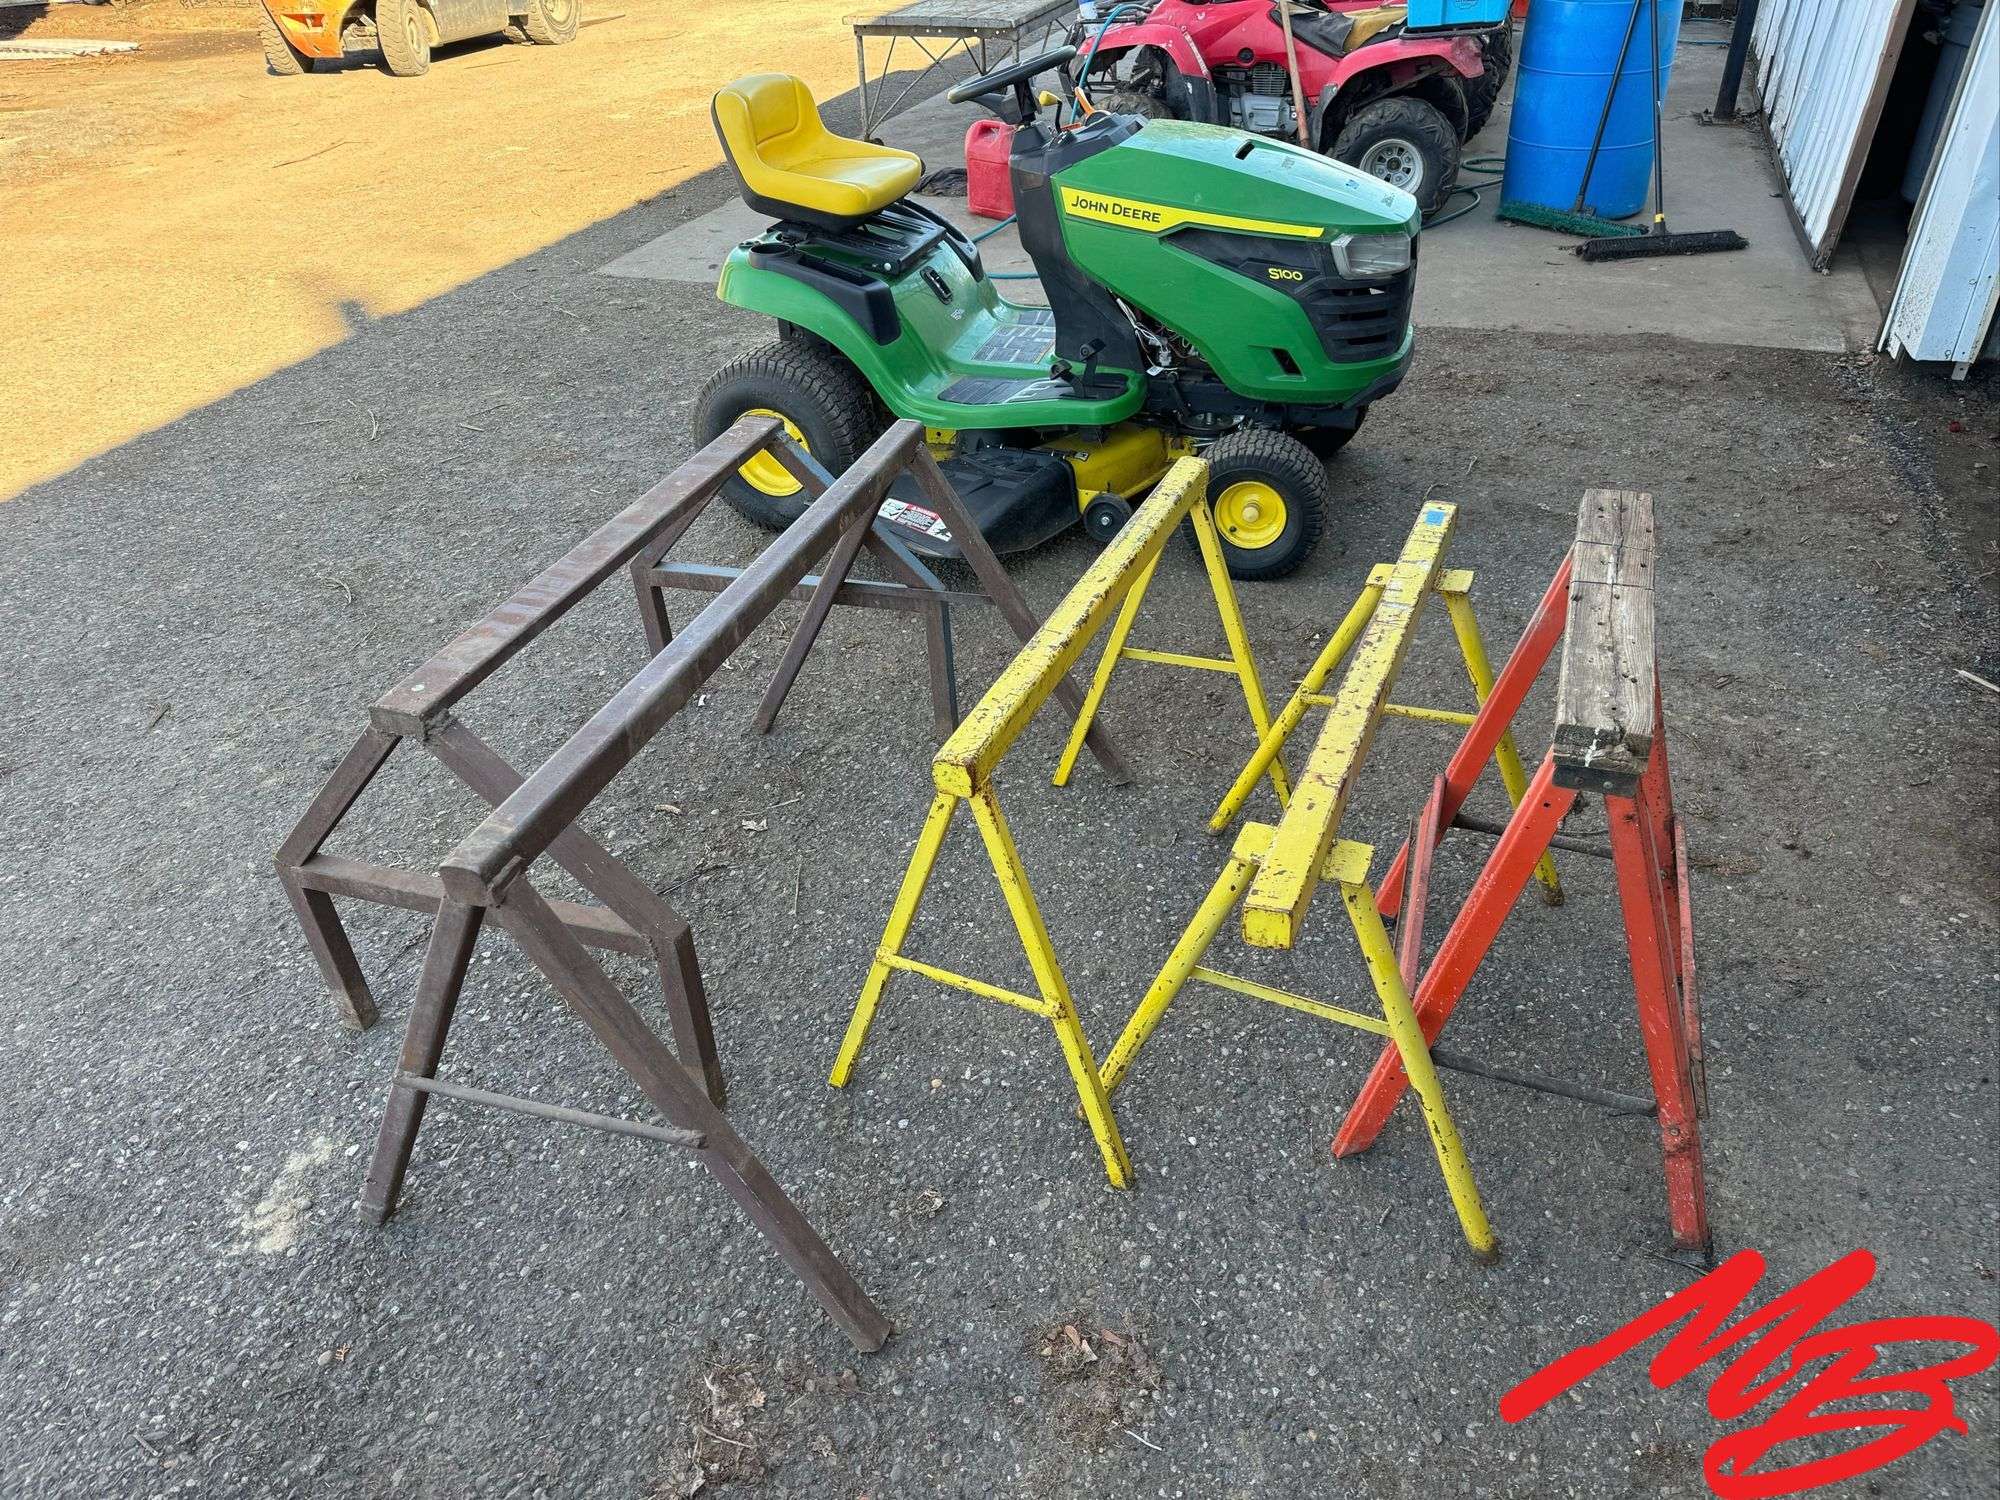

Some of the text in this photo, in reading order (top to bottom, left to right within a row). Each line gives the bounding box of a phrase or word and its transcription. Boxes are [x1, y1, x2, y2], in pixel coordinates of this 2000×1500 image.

[1071, 195, 1161, 223] JOHN DEERE
[1268, 267, 1303, 281] S100
